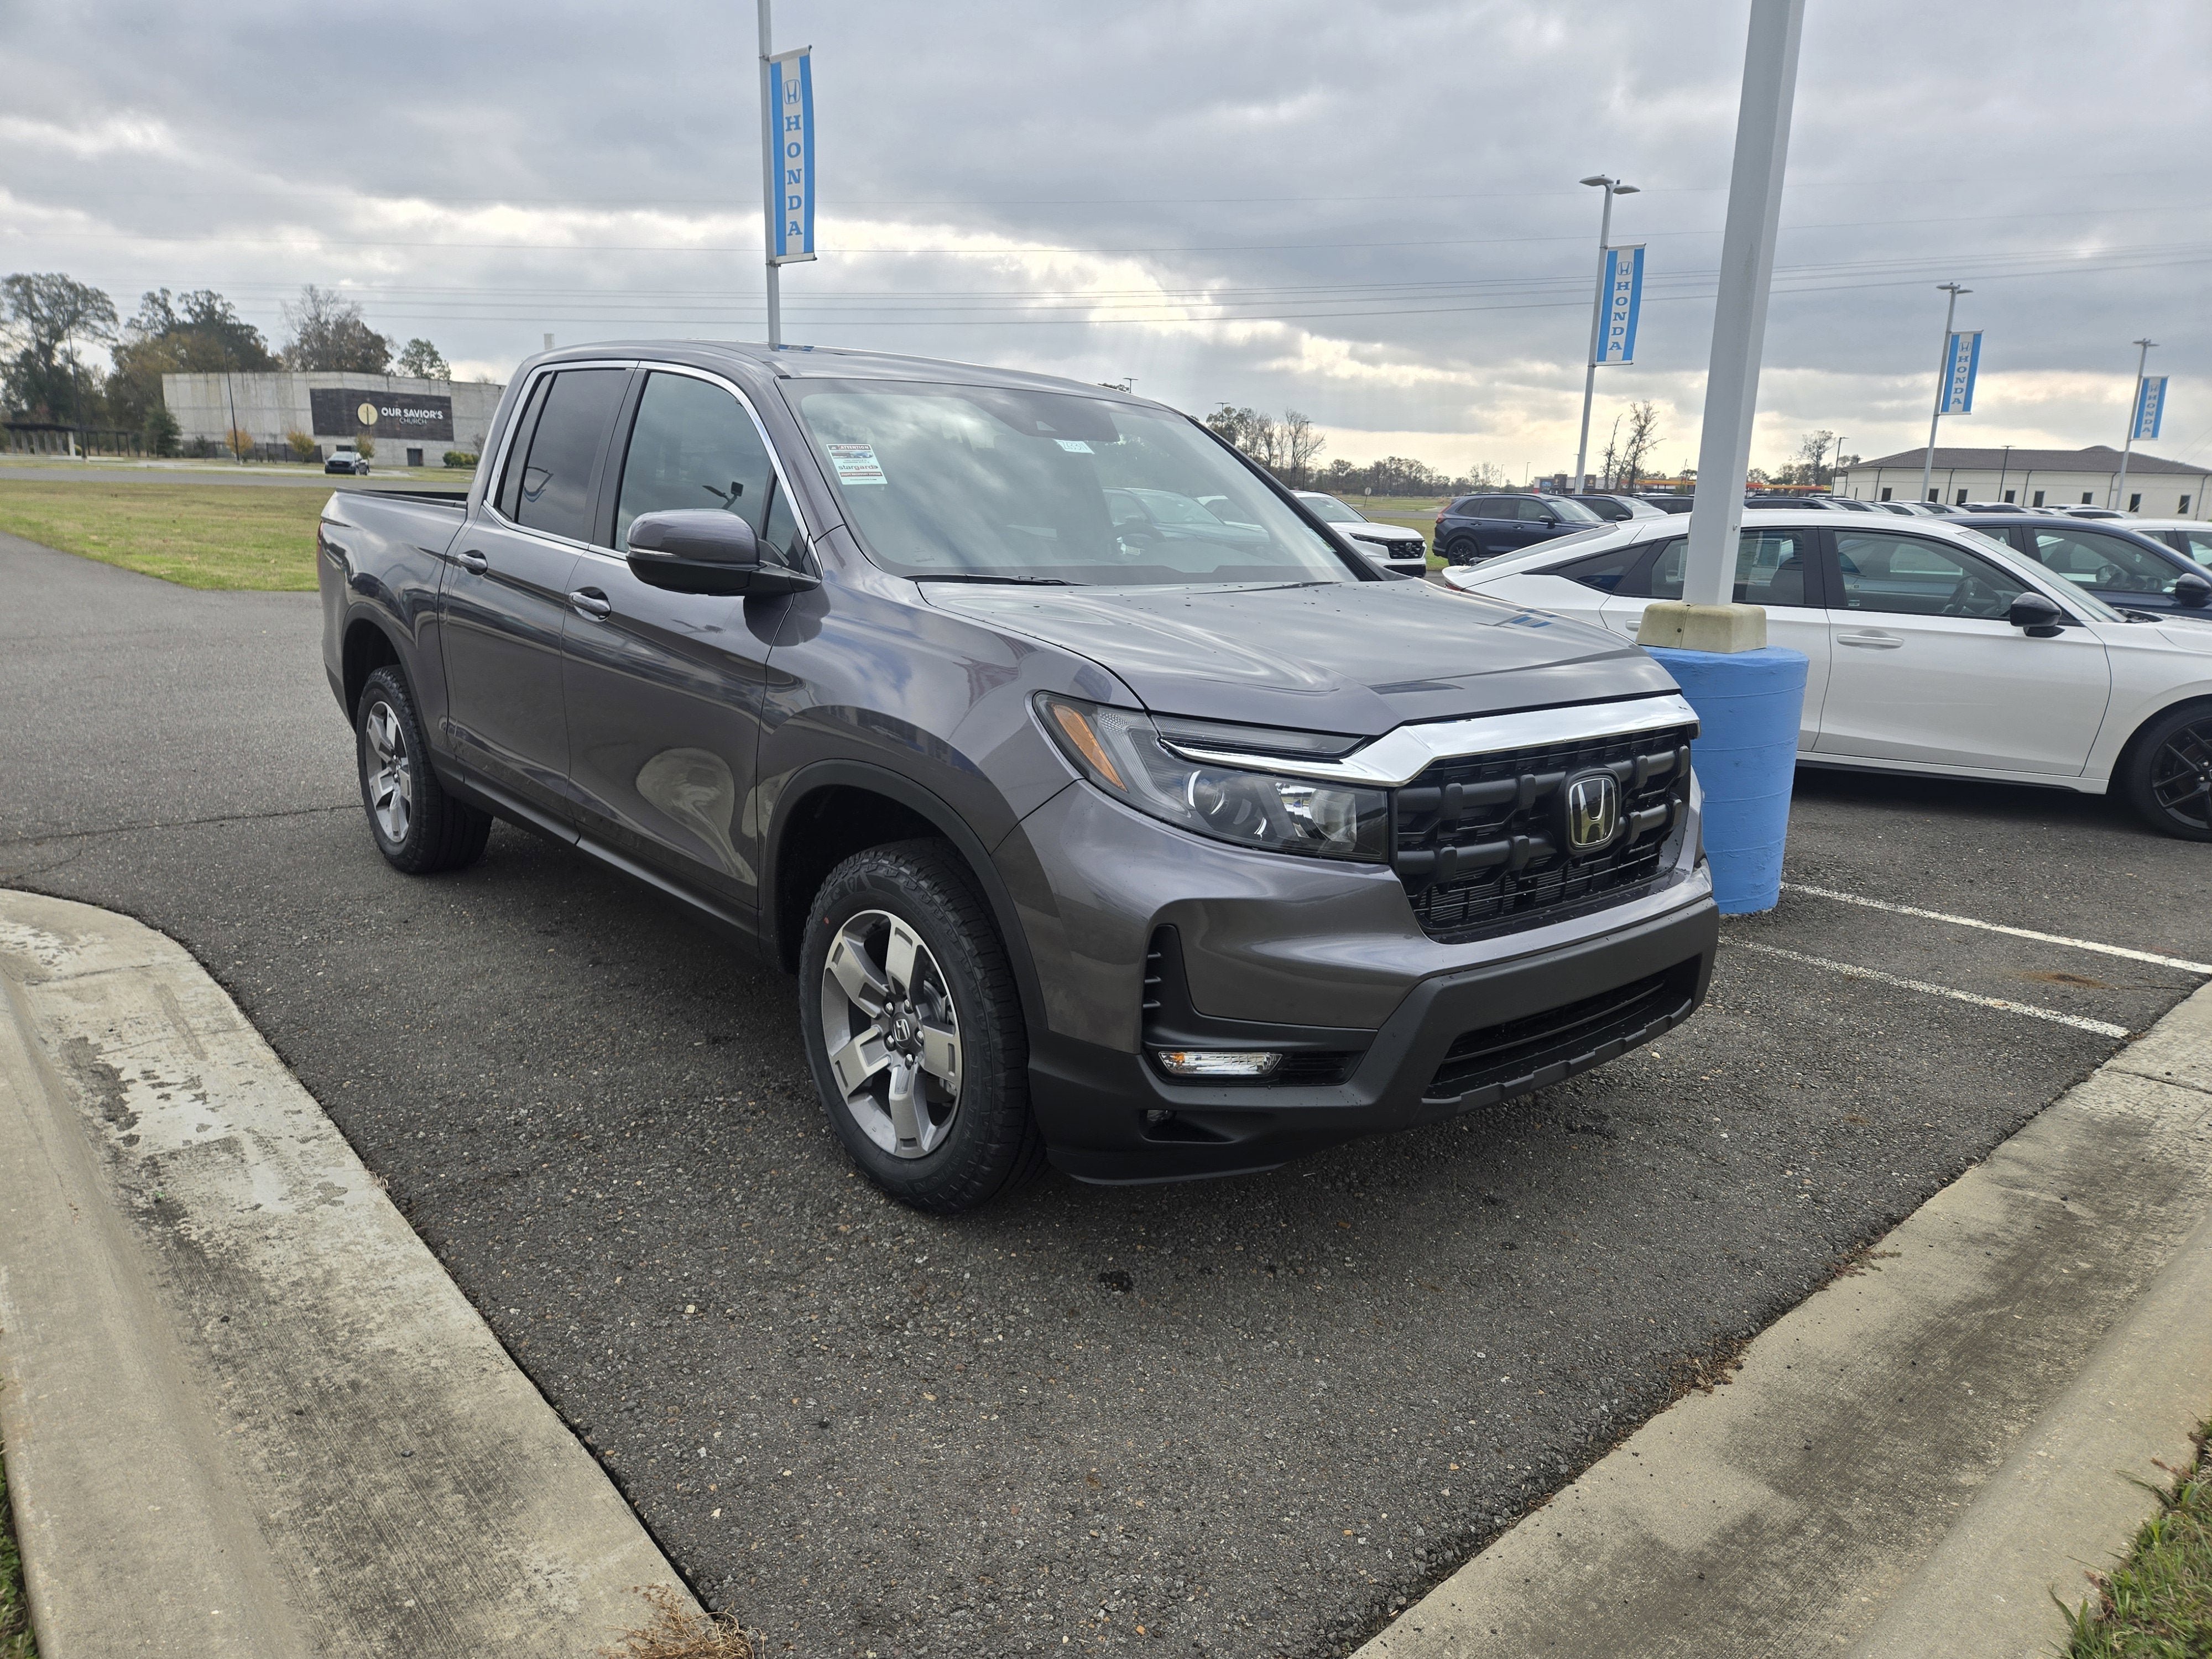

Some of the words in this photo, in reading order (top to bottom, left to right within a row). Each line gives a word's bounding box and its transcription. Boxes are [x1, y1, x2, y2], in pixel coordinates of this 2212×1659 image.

[785, 114, 802, 236] HONDA
[1608, 281, 1631, 351] HONDA
[1952, 355, 1970, 404] HONDA
[381, 407, 402, 417] OUR
[403, 408, 444, 420] SAVIOR'S
[399, 417, 427, 425] CHURCH
[2142, 395, 2157, 432] HONDA
